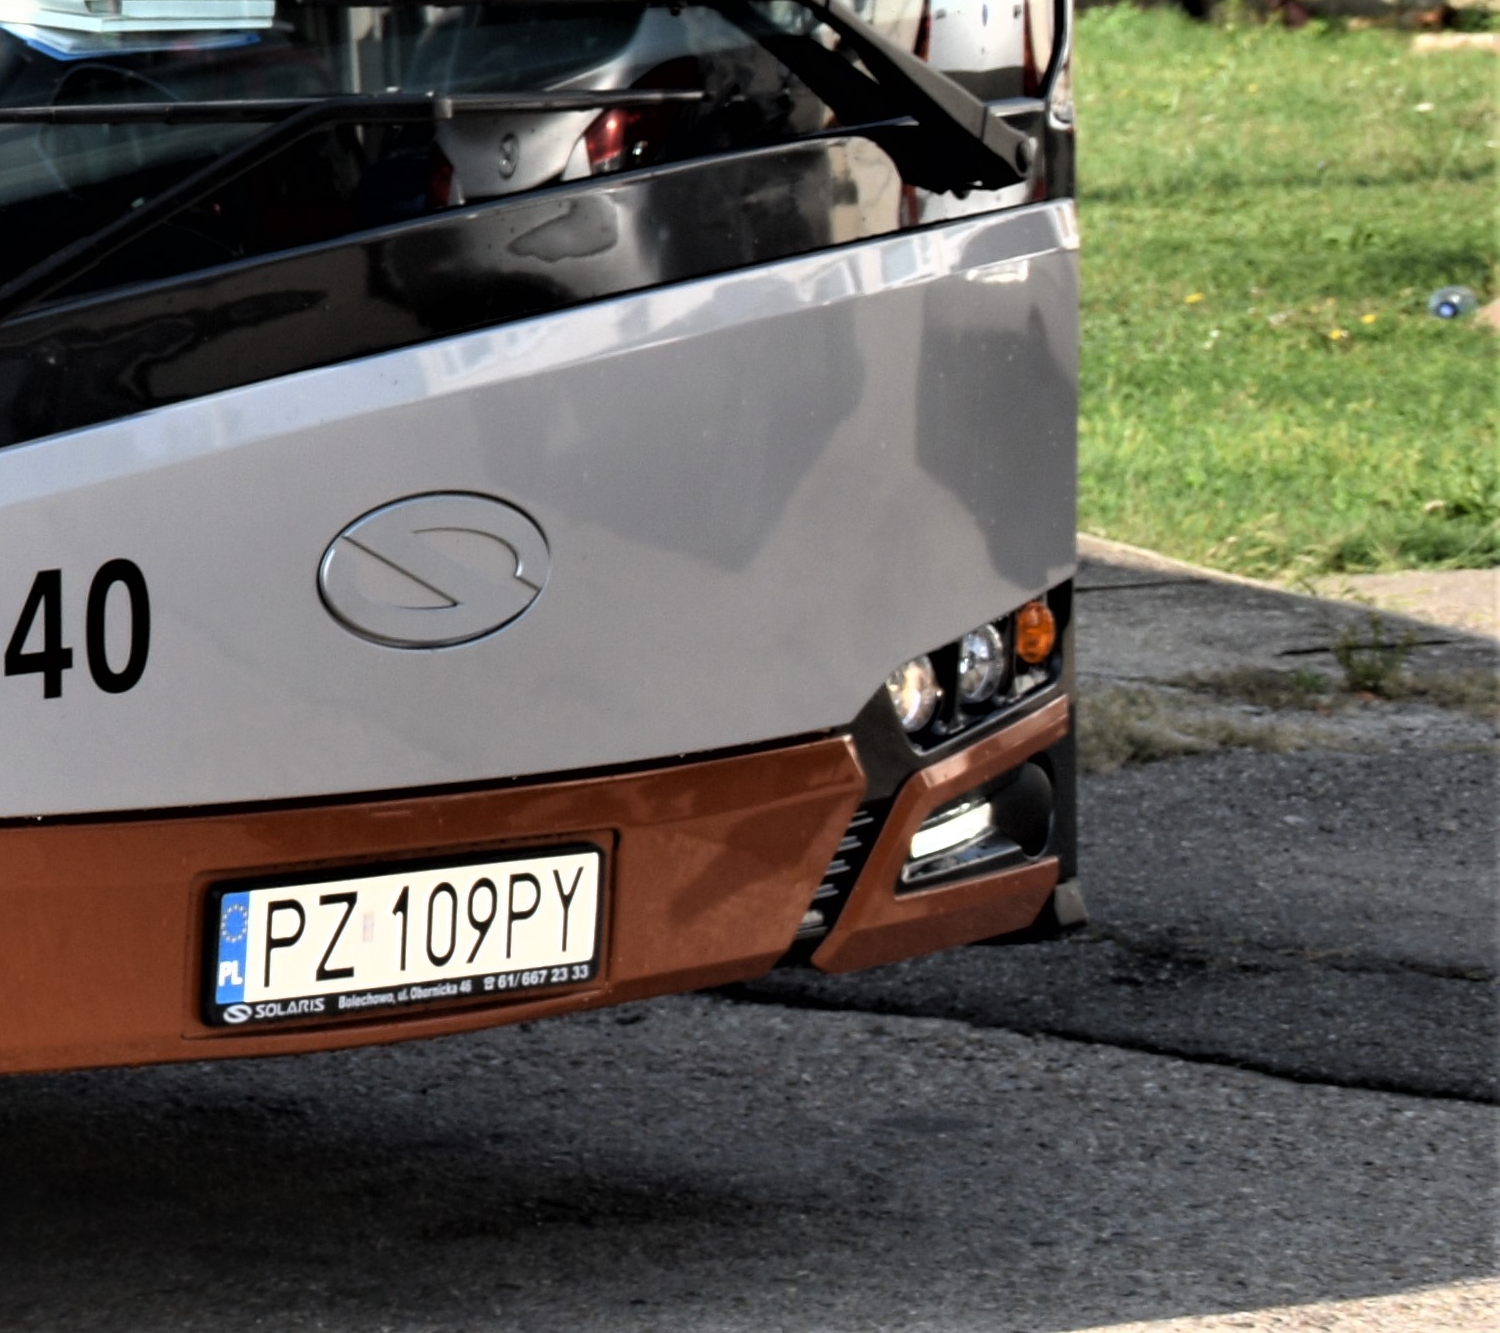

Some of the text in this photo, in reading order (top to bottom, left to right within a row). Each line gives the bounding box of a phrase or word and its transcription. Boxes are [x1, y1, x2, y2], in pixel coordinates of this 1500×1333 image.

[262, 866, 585, 989] PZ 109PY
[218, 960, 243, 987] PL
[254, 997, 326, 1020] SOLARIS
[551, 967, 569, 983] 23
[571, 964, 590, 981] 33
